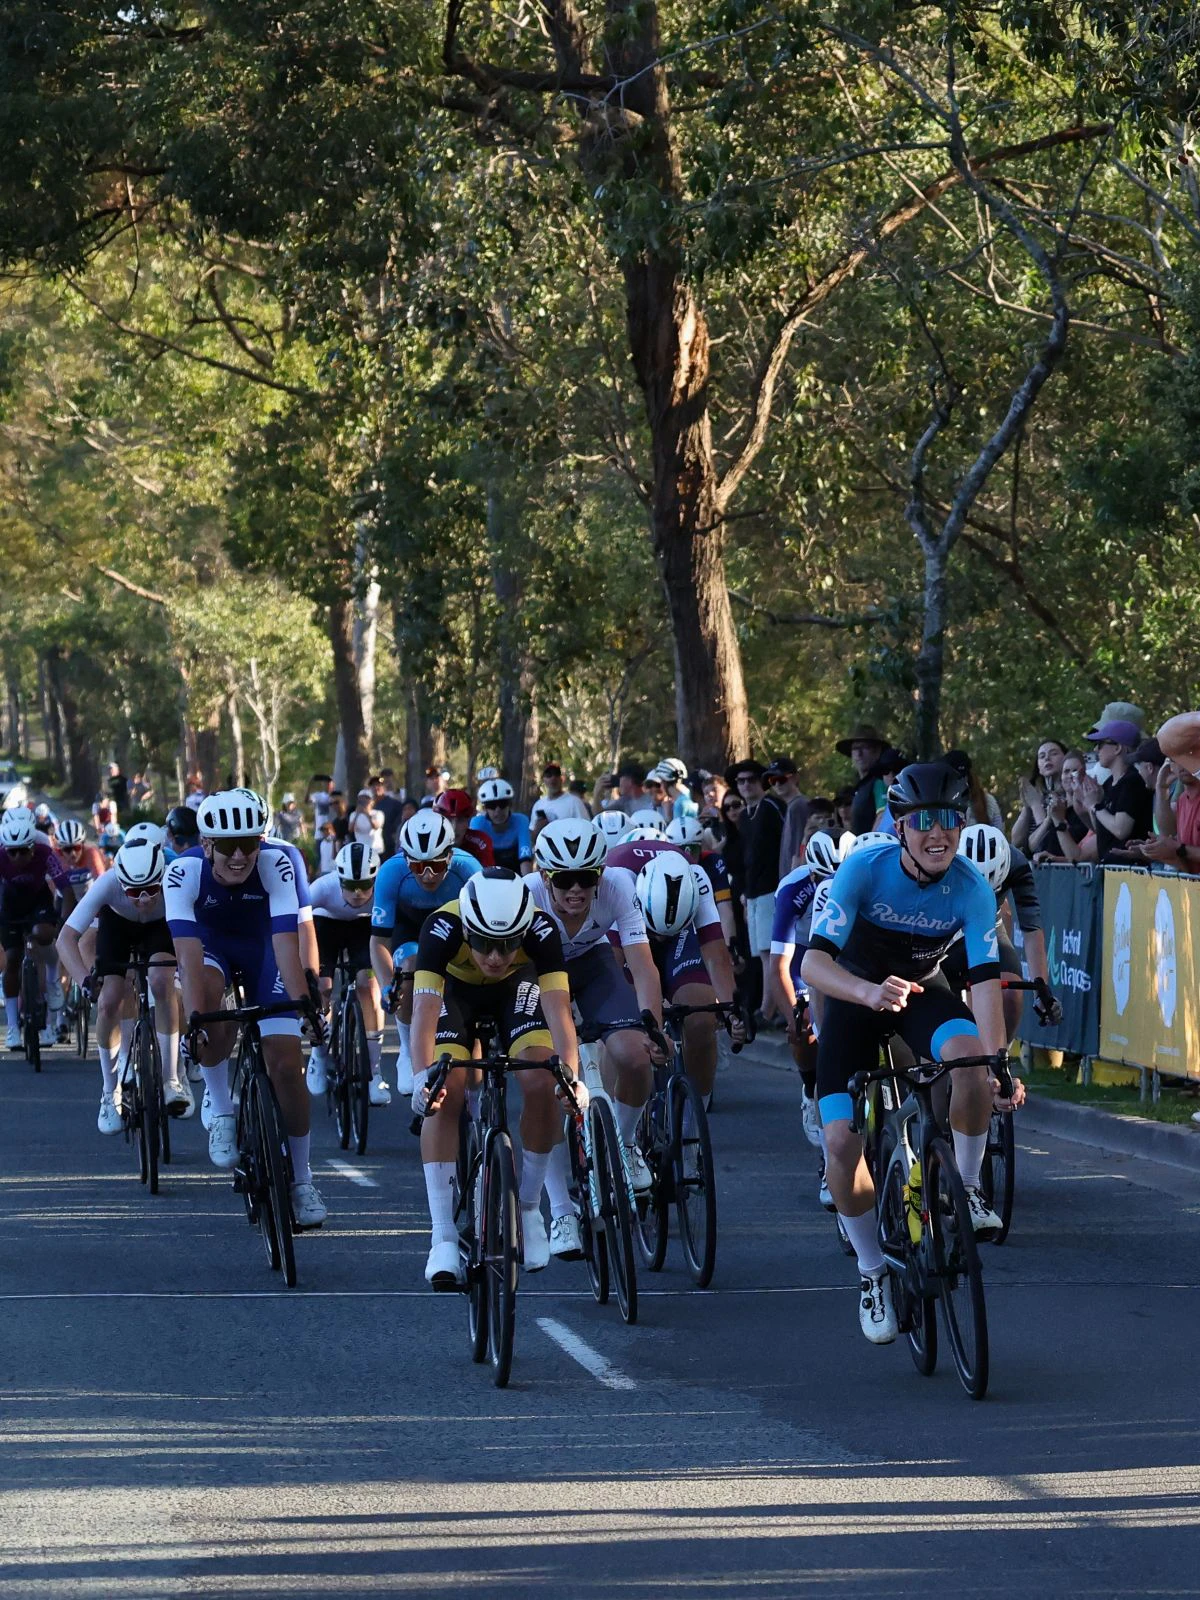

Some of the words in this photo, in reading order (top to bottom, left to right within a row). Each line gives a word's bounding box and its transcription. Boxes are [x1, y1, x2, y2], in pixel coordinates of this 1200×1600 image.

[168, 865, 186, 889] VIC
[275, 855, 294, 883] VIC
[793, 881, 816, 909] NSW
[815, 888, 829, 912] VIC
[430, 918, 455, 942] WA
[870, 902, 957, 931] Rauland
[514, 980, 532, 1015] WESTERN
